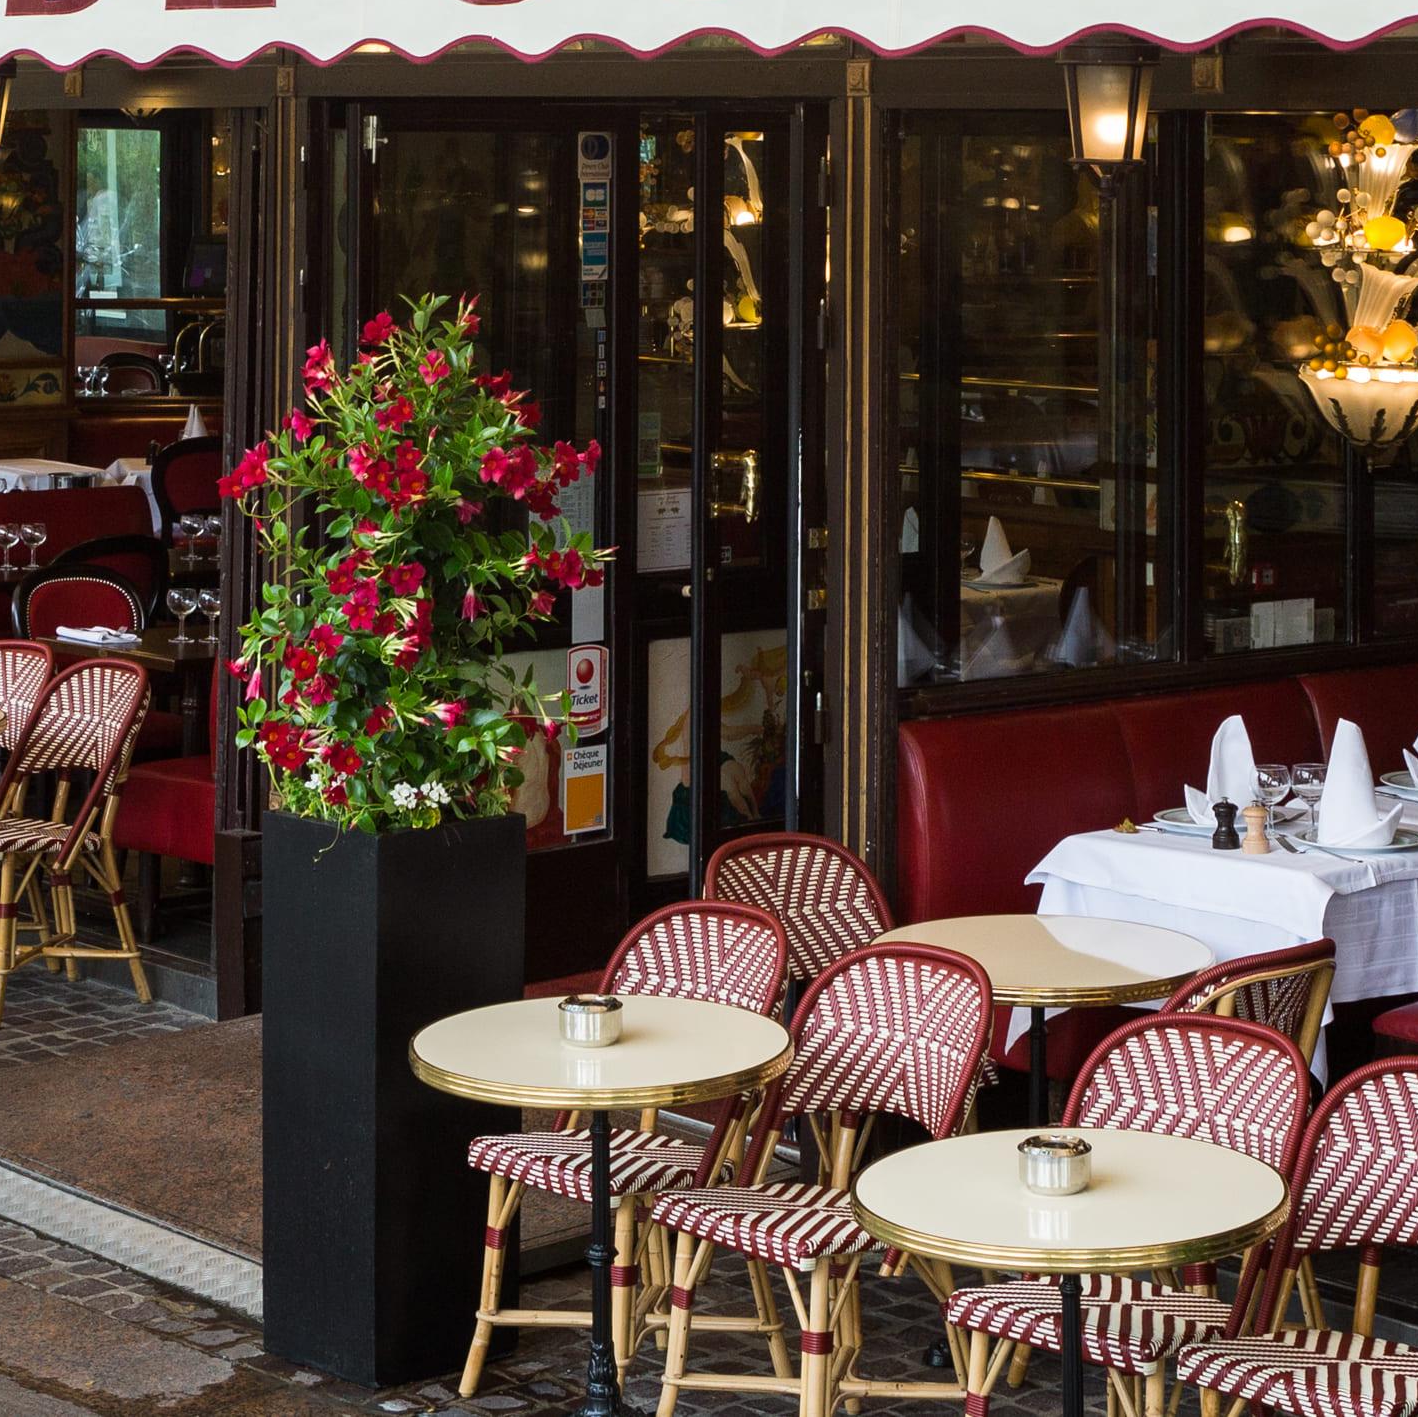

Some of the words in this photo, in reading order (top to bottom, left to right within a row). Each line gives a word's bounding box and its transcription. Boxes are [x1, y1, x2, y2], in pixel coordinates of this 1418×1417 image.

[571, 693, 599, 706] Ticket
[573, 749, 599, 760] Chèque
[573, 759, 603, 771] Déjeuner
